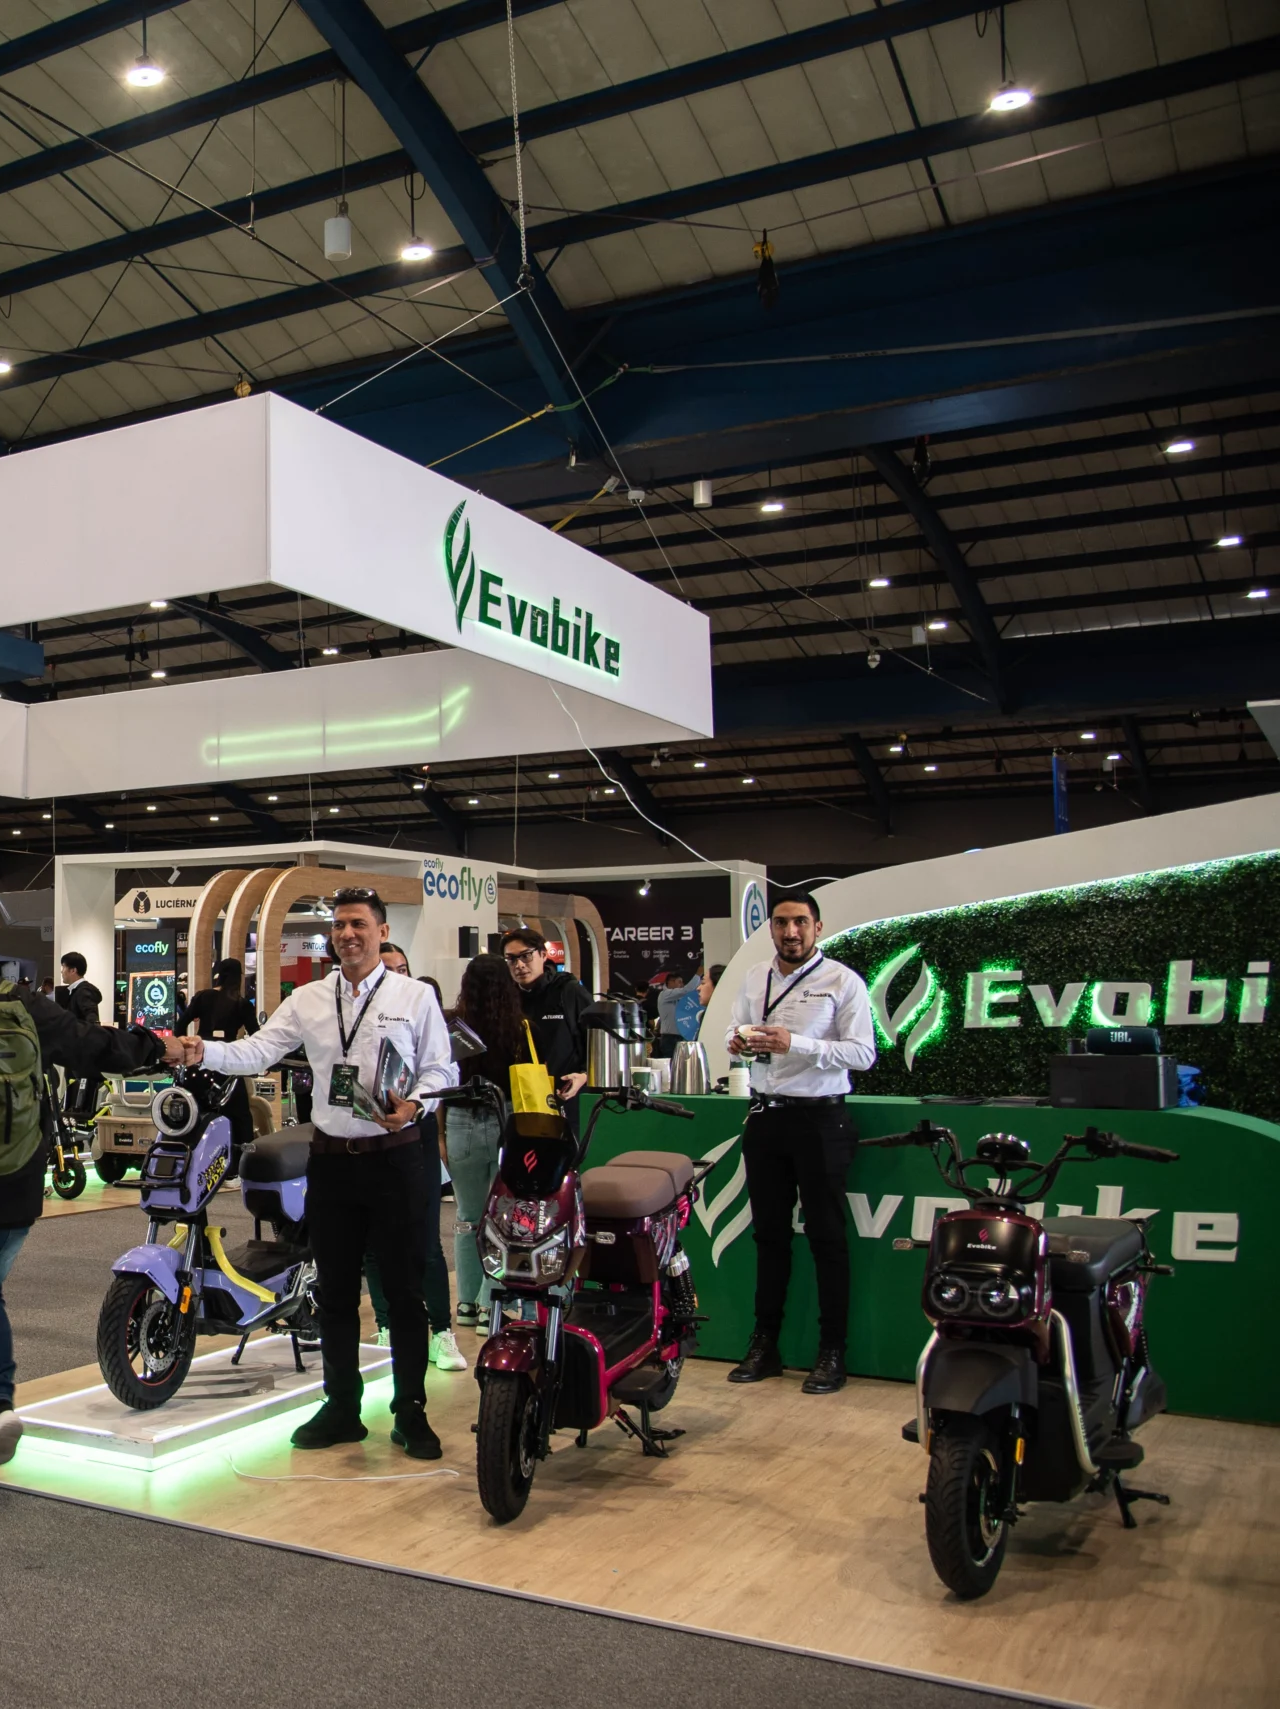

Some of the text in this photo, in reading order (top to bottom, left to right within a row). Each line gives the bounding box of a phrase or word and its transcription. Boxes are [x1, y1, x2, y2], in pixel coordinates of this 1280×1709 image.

[478, 568, 620, 678] Evobike
[424, 858, 444, 872] ecofly
[424, 866, 483, 910] ecofly
[681, 926, 693, 940] 3
[135, 941, 169, 956] ecofly
[964, 960, 1270, 1028] Evobi
[1110, 1031, 1131, 1042] JBL
[538, 1200, 547, 1235] Evobike
